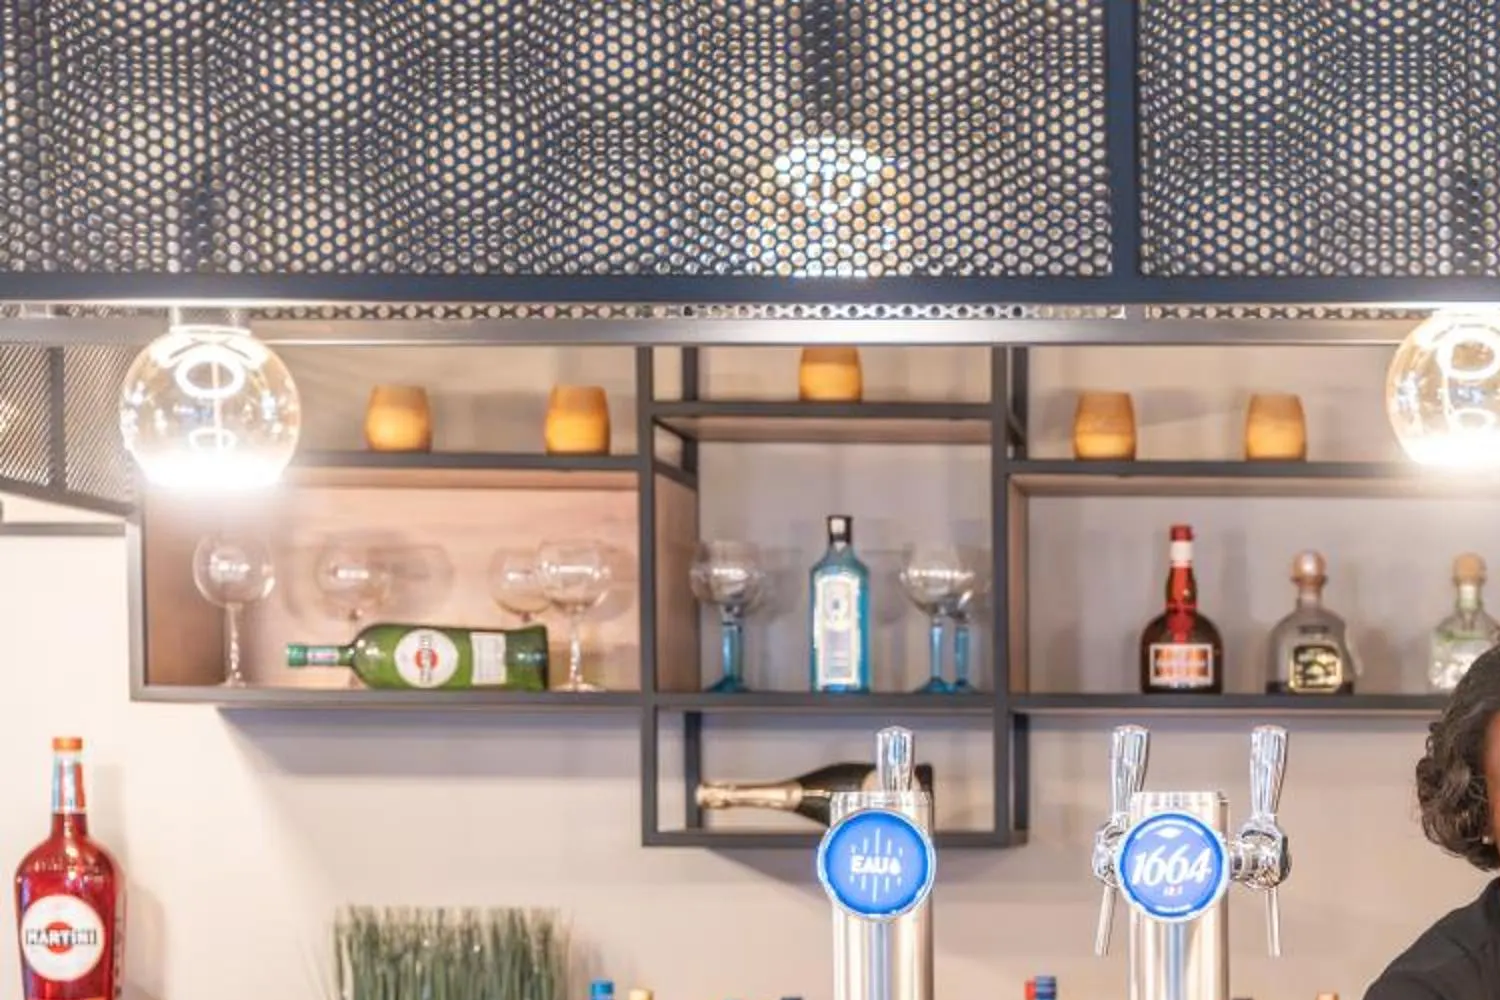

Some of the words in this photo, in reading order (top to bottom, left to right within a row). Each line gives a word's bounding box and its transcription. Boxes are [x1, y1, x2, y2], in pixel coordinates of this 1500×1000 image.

[851, 854, 890, 875] EAU
[1131, 843, 1213, 887] 1664
[26, 927, 98, 945] MARTINI
